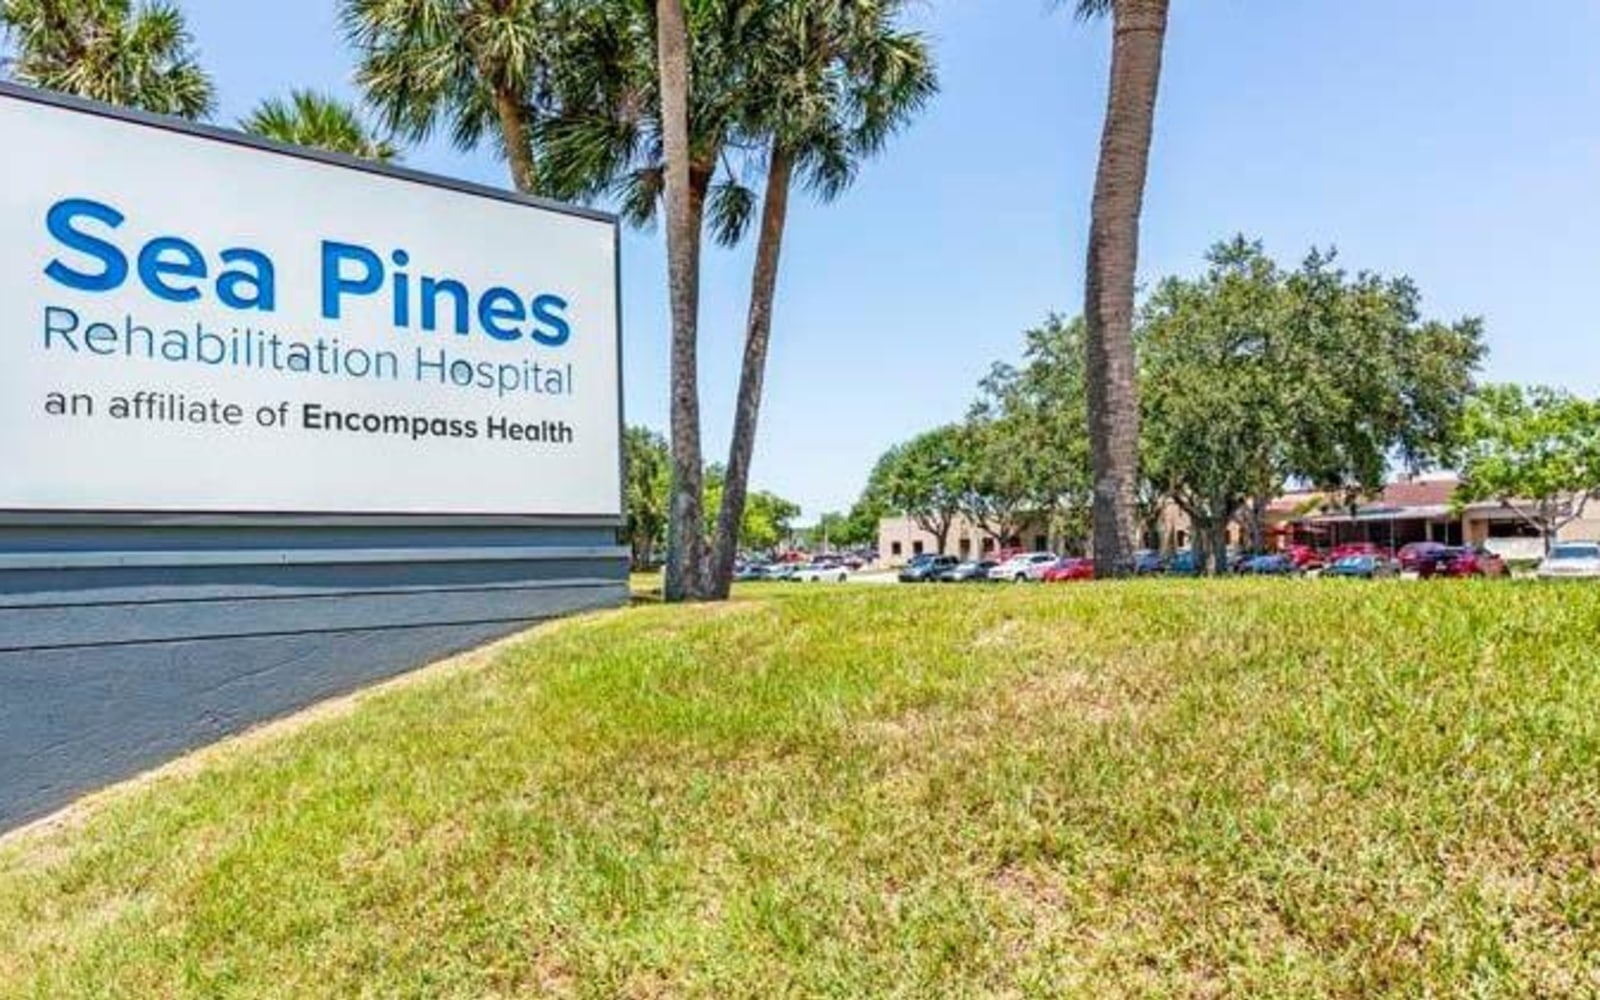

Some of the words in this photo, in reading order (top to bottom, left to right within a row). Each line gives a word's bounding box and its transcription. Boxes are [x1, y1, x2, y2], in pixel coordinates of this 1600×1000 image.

[43, 197, 276, 312] Sea
[320, 239, 571, 348] Pines
[44, 305, 398, 380] Rehabilitation
[416, 346, 573, 398] Hospital
[45, 392, 92, 416] an
[109, 391, 242, 424] affiliate
[256, 401, 288, 427] of
[303, 403, 478, 440] Encompass
[487, 416, 573, 443] Health
